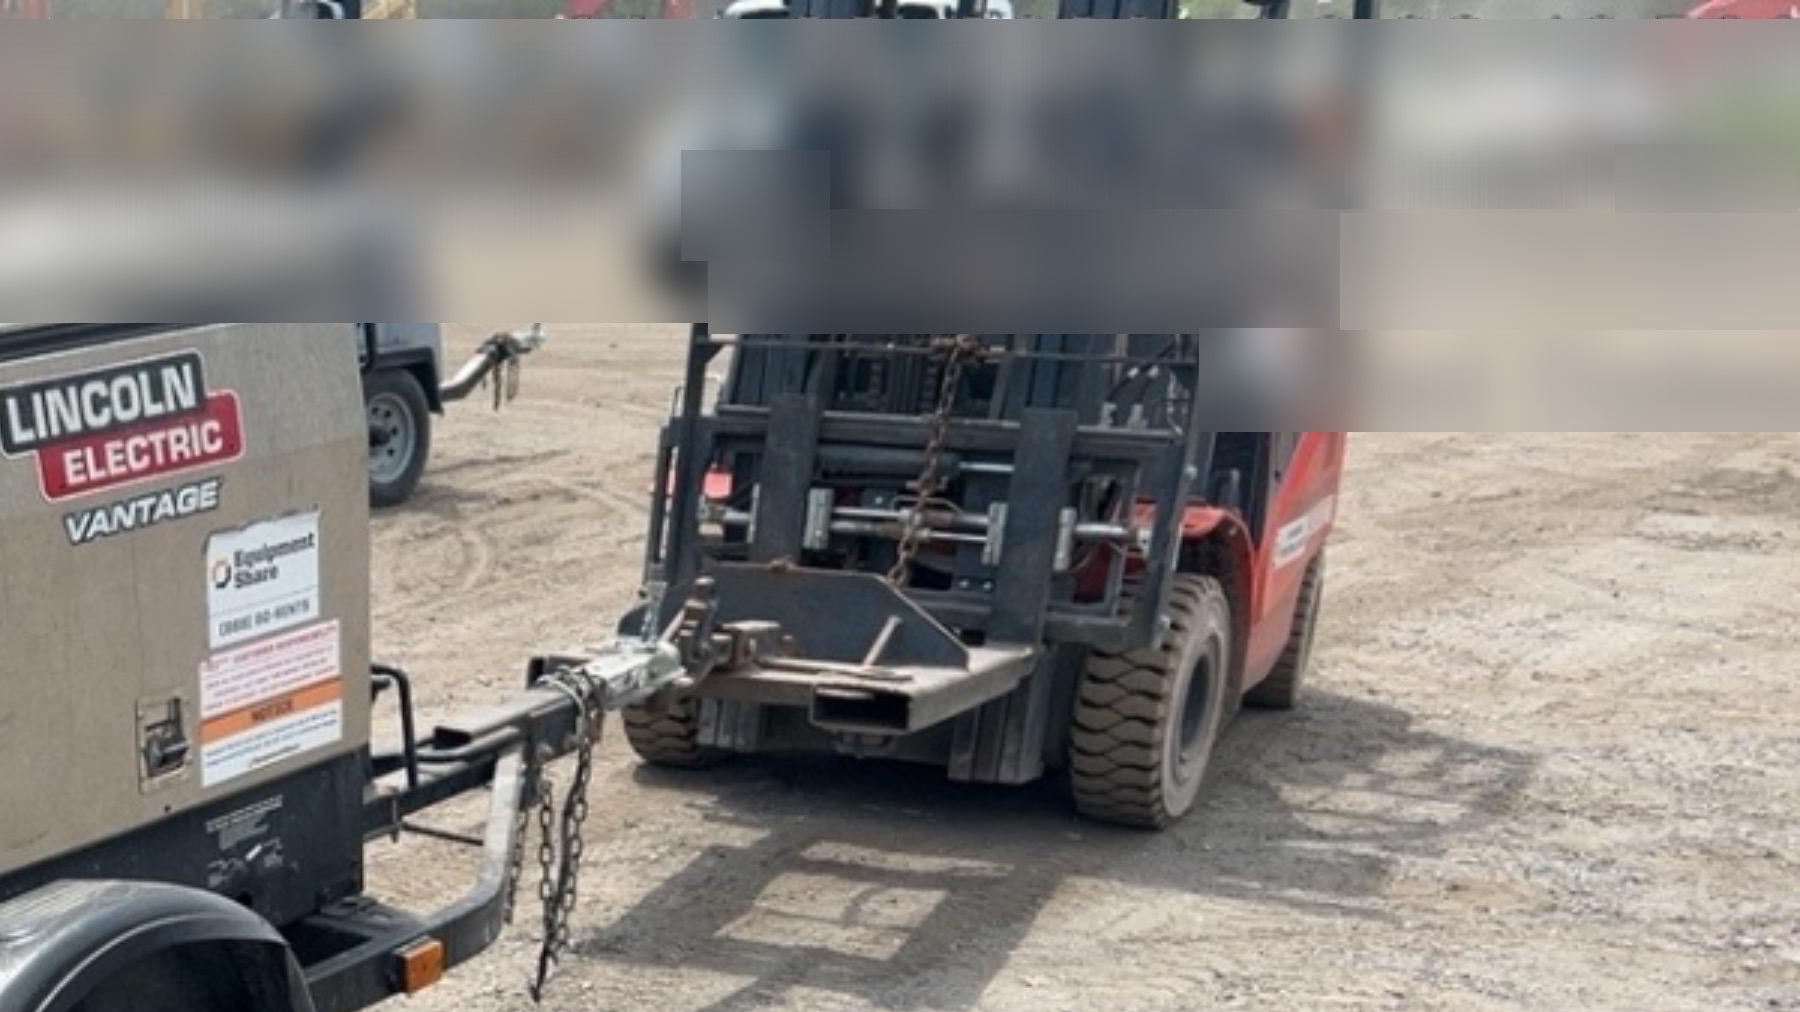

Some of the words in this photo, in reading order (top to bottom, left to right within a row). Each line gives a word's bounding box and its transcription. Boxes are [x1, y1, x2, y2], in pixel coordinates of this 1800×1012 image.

[5, 362, 198, 445] LINCOLN
[62, 419, 224, 487] ELECTRIC
[65, 479, 222, 545] VANTAGE
[233, 532, 316, 570] Equipment
[233, 565, 279, 590] Share
